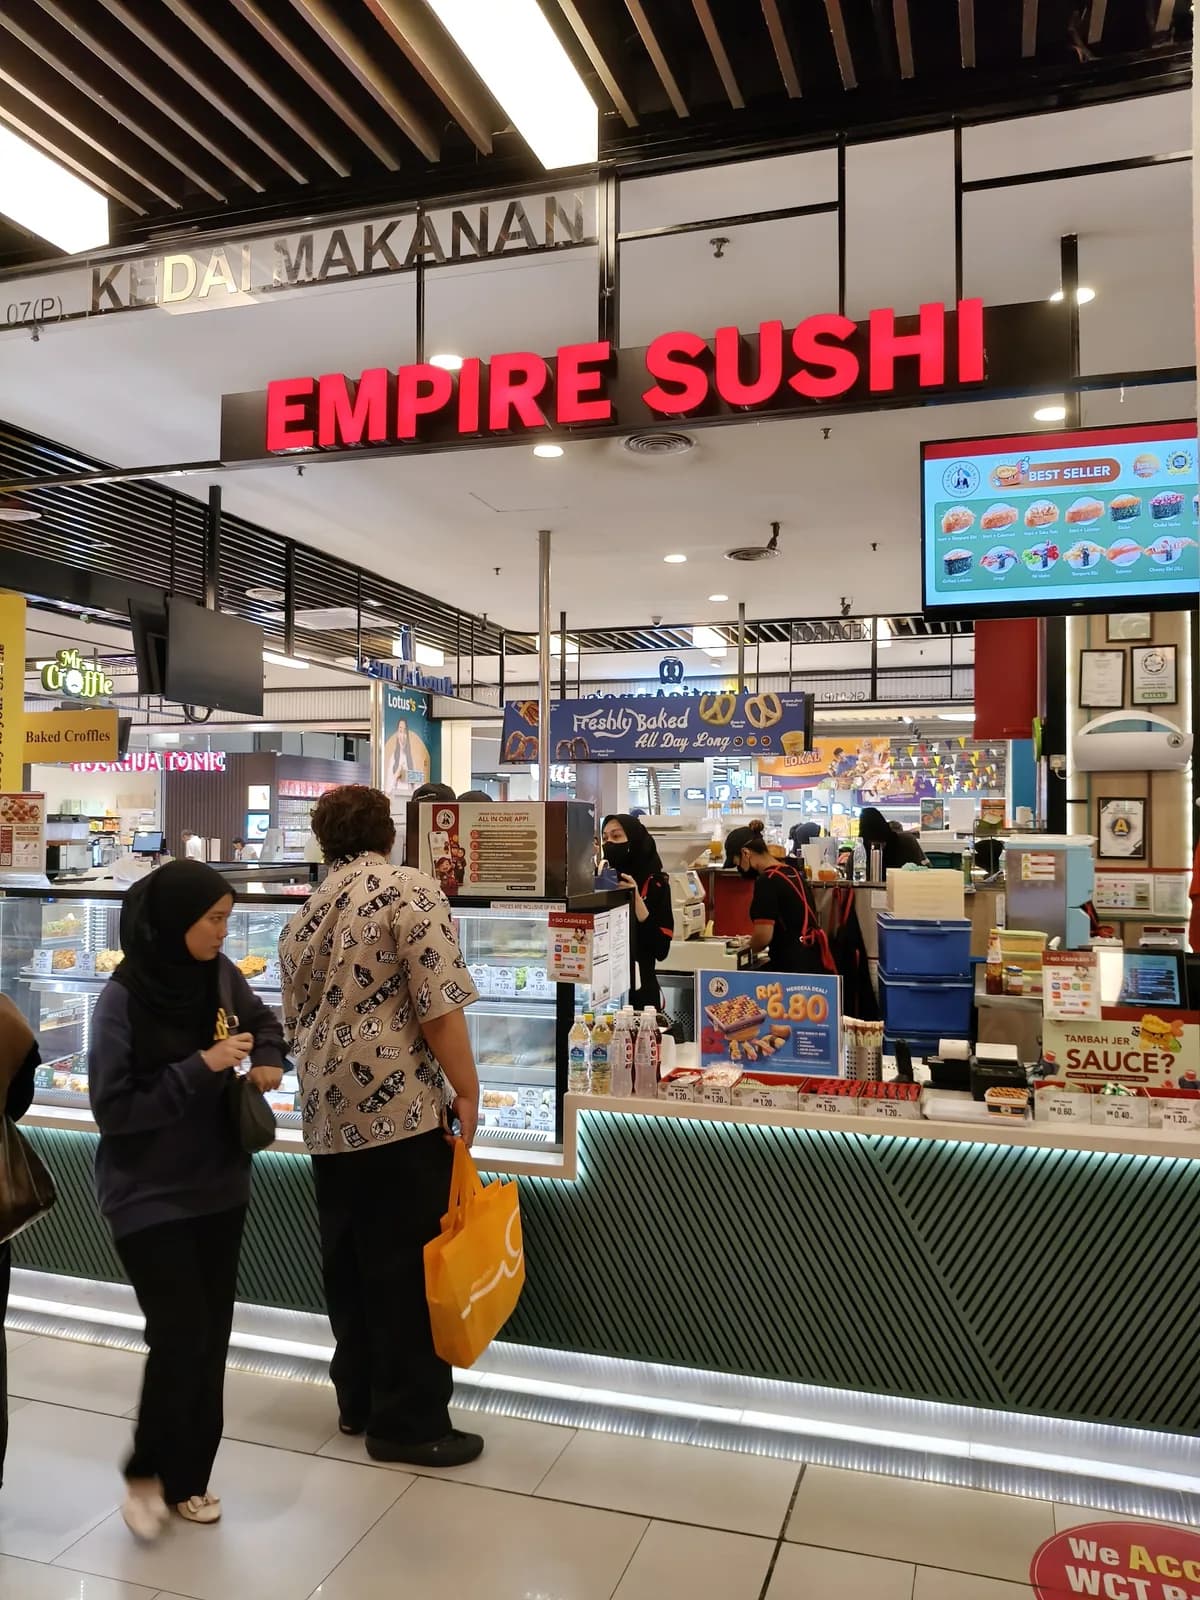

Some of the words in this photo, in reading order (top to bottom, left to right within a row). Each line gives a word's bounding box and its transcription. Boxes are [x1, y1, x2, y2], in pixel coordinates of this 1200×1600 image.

[90, 244, 254, 311] KEDAI
[272, 194, 585, 288] MAKANAN
[266, 341, 612, 452] EMPIRE
[641, 297, 984, 415] SUSHI
[1029, 468, 1060, 482] BEST
[1063, 465, 1111, 480] SELLER
[61, 649, 86, 670] Mr.
[388, 693, 416, 712] Lotus's
[573, 707, 633, 738] Freshly
[637, 707, 690, 732] Baked
[26, 730, 60, 743] Baked
[64, 729, 111, 742] Croffles
[635, 731, 660, 748] All
[660, 732, 689, 753] Day
[692, 731, 731, 752] Long
[1114, 817, 1129, 832] A
[756, 982, 784, 1000] RM
[786, 985, 811, 993] MERDEKA
[767, 993, 829, 1024] 6.80
[1065, 1034, 1109, 1045] TAMBAH
[1111, 1037, 1130, 1046] JER
[1066, 1048, 1175, 1075] SAUCE?
[675, 1093, 687, 1101] 1.20
[760, 1099, 772, 1107] 1.20
[824, 1104, 836, 1112] 1.20
[885, 1109, 897, 1117] 1.20
[1057, 1107, 1072, 1116] 0.60
[1114, 1111, 1130, 1120] 0.40
[1172, 1115, 1188, 1124] 1.20
[1068, 1537, 1120, 1566] We
[1065, 1565, 1150, 1600] WCT
